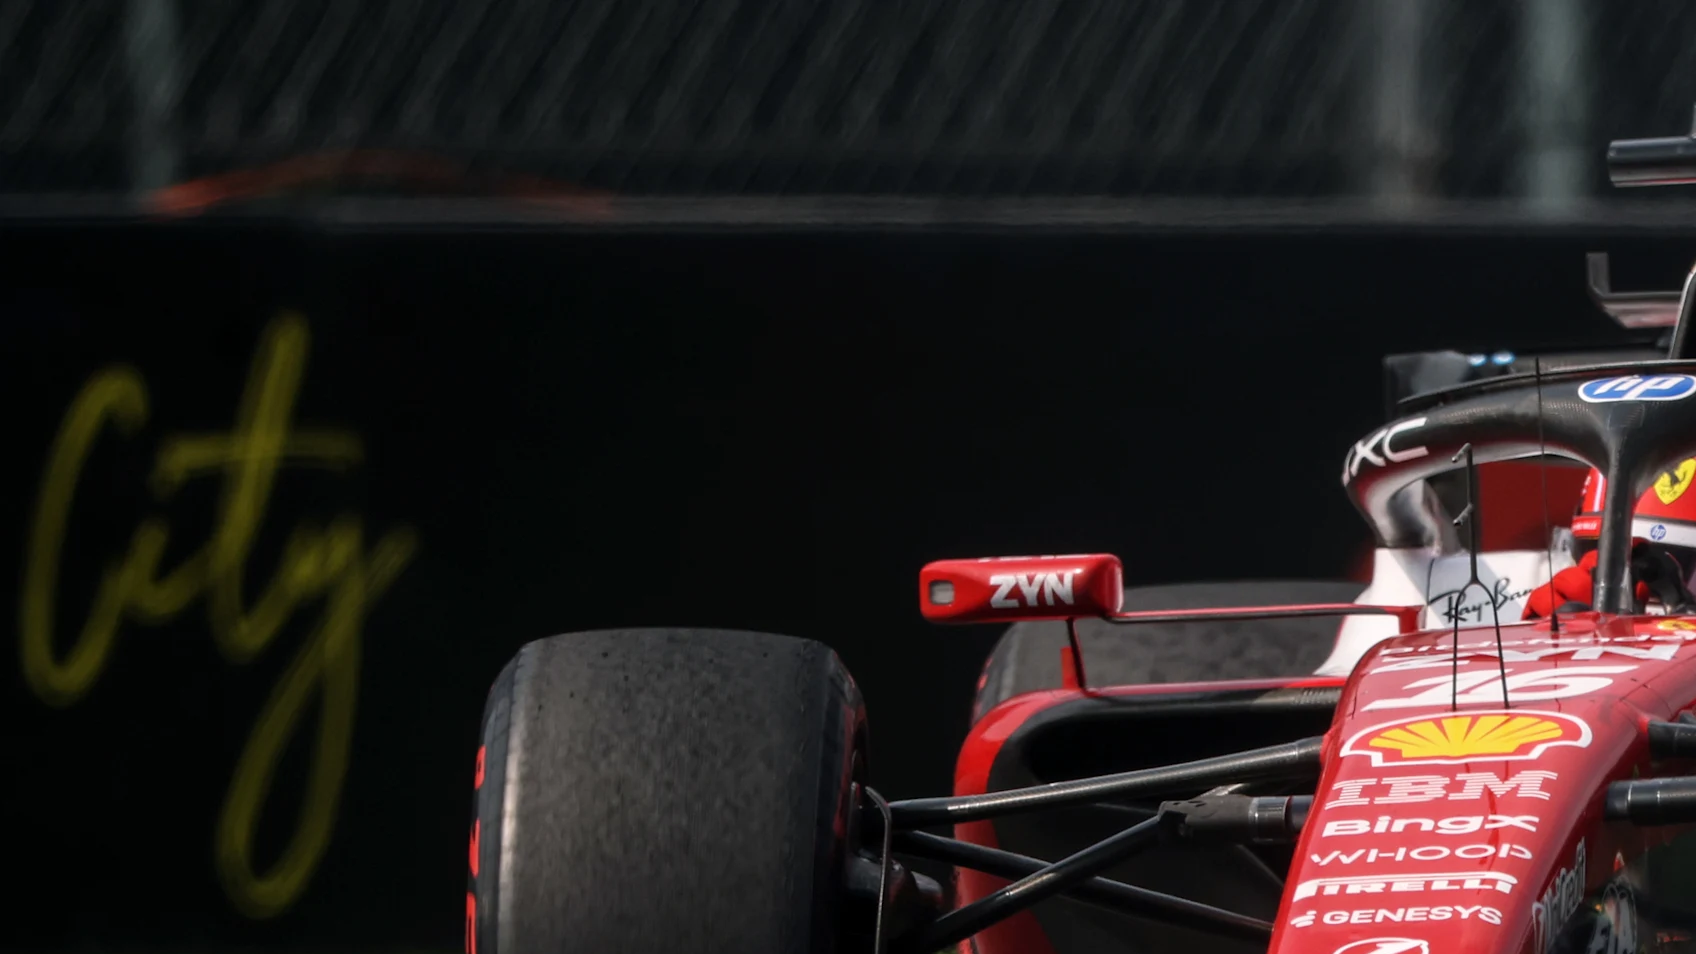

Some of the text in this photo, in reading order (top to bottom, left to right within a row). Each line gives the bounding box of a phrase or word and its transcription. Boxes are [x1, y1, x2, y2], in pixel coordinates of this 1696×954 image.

[1590, 375, 1688, 400] hp
[990, 571, 1074, 608] ZYN
[20, 312, 418, 920] City
[1370, 643, 1680, 675] ZYN
[1361, 665, 1640, 712] 16
[1324, 770, 1558, 810] IBM
[1311, 843, 1532, 866] WHOOP
[1293, 871, 1518, 902] PIRELLI
[1323, 905, 1502, 925] GENESYS
